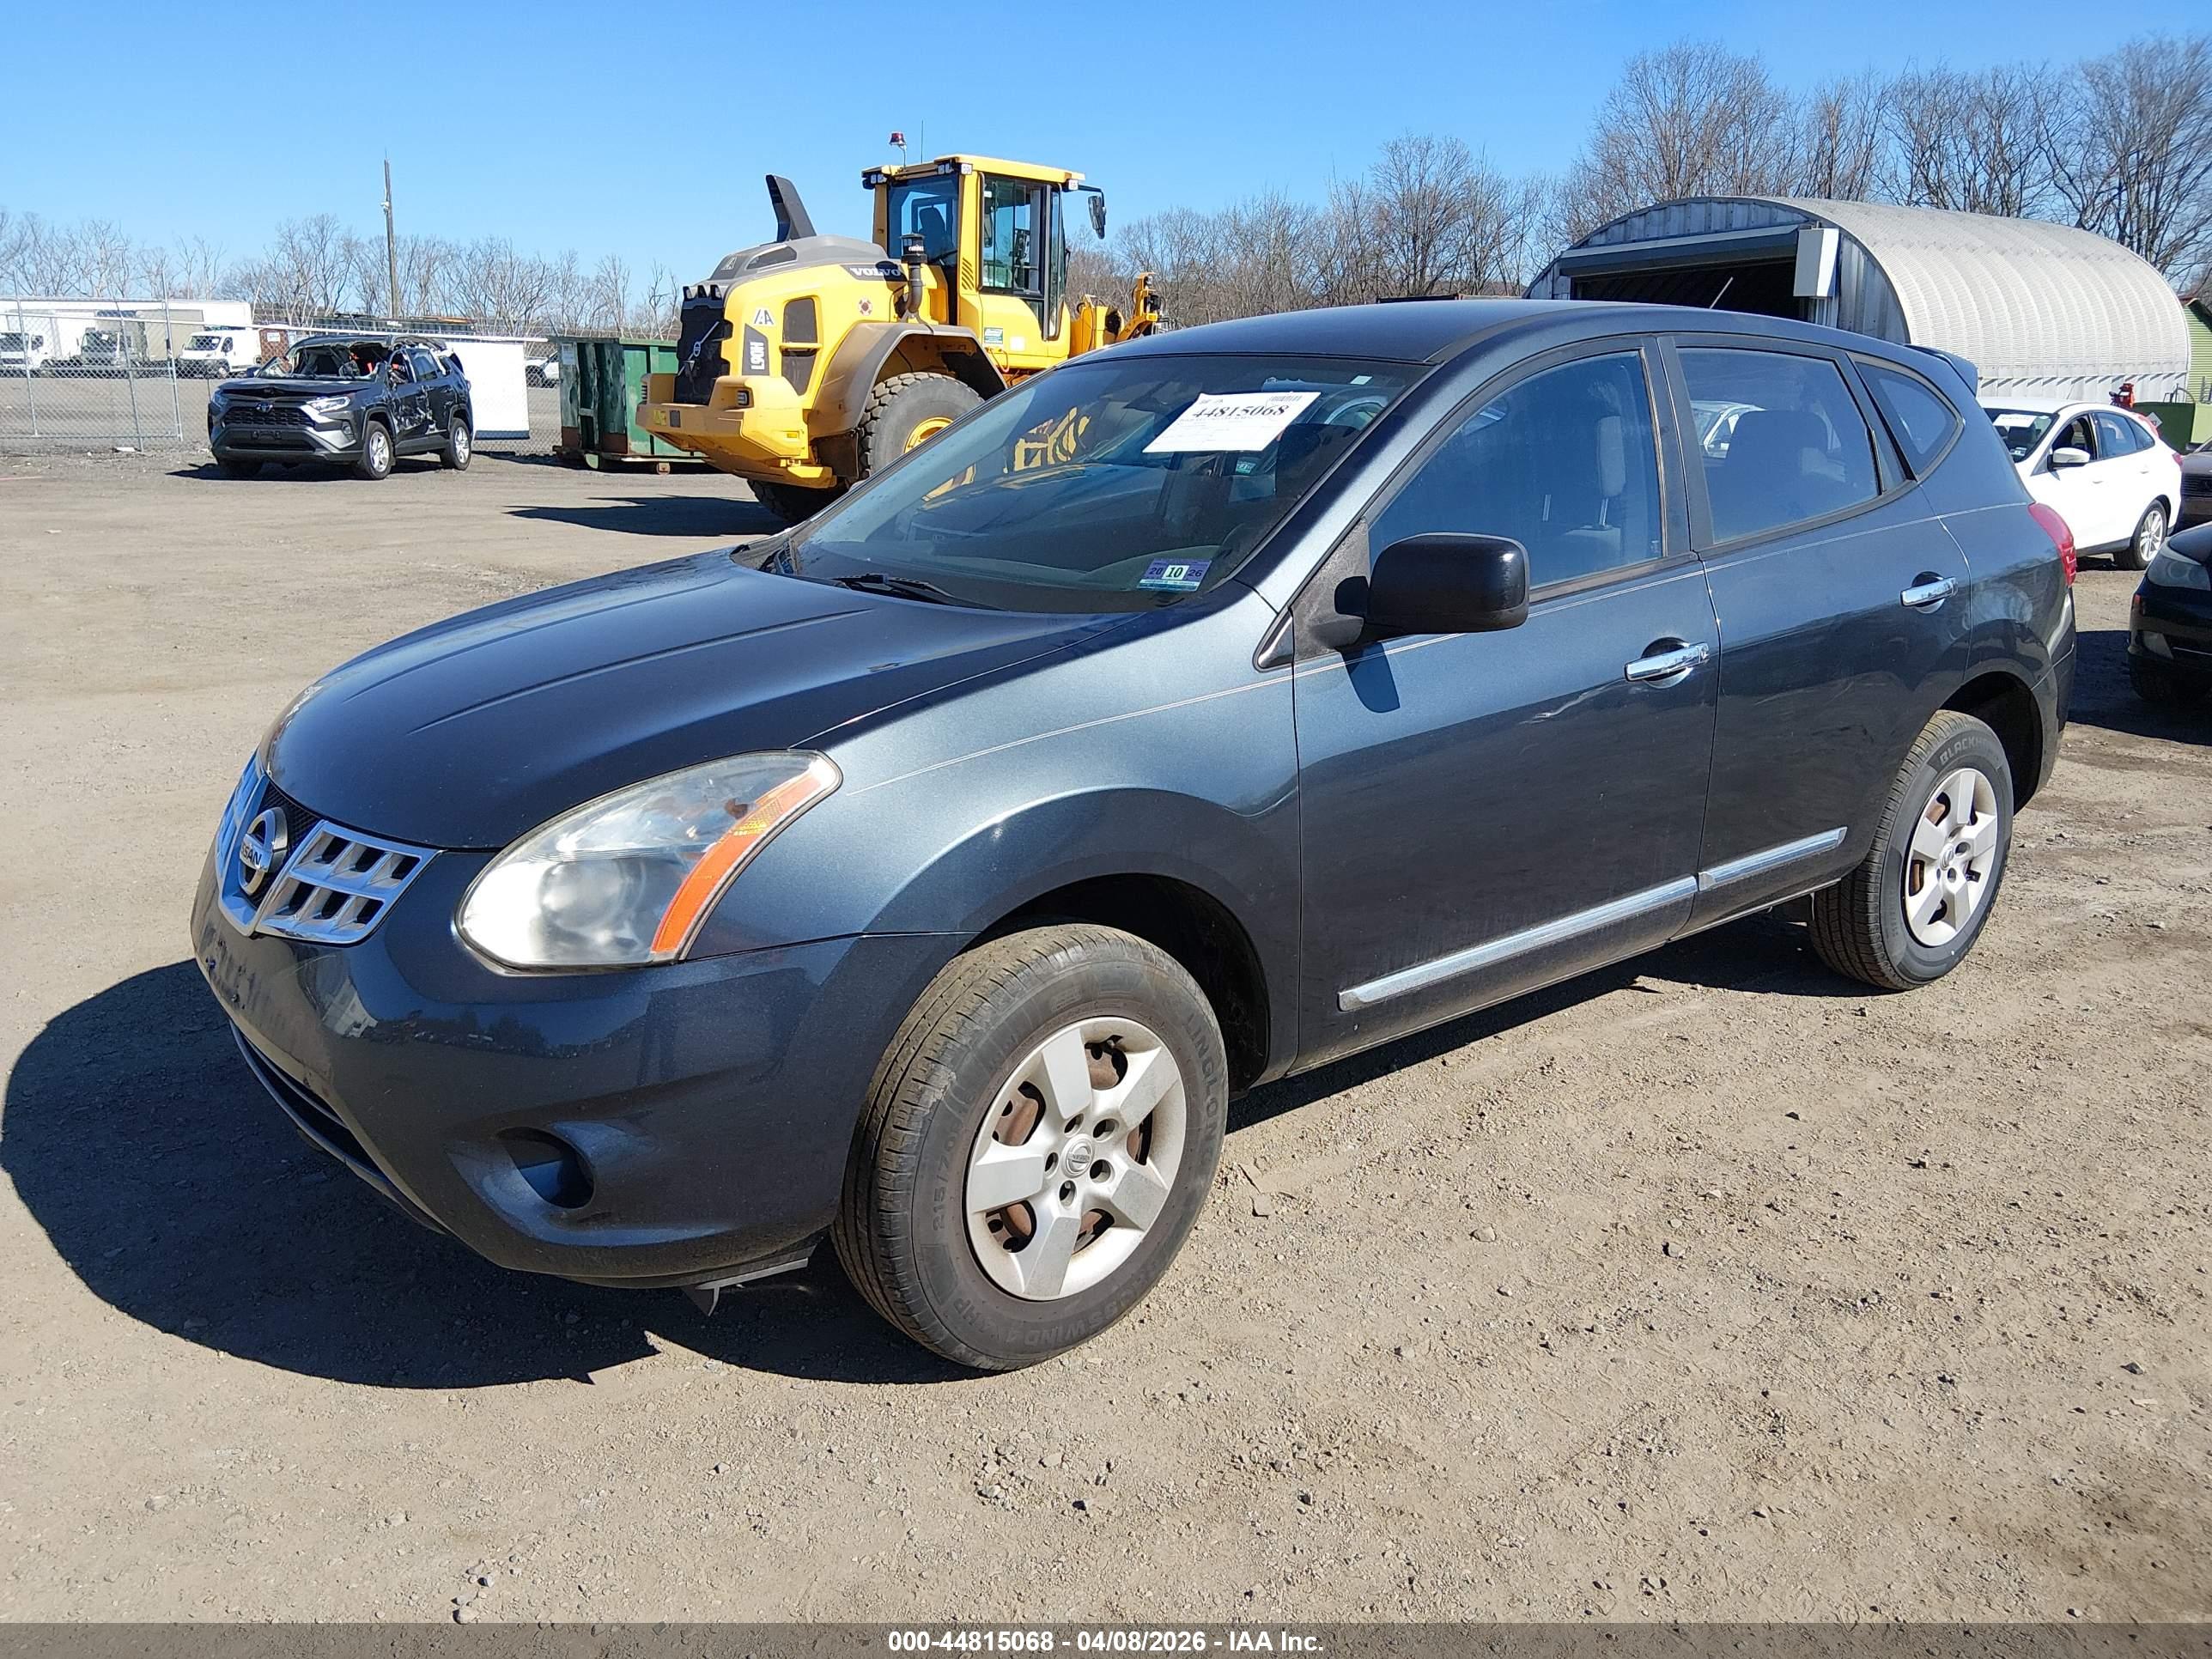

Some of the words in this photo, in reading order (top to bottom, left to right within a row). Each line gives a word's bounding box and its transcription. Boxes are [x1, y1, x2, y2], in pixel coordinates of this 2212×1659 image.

[850, 267, 901, 276] VOLVO
[750, 342, 765, 370] L90H
[1192, 404, 1290, 418] 44815068
[1149, 567, 1164, 575] 20
[1165, 567, 1183, 578] 10
[240, 841, 263, 866] SSAN
